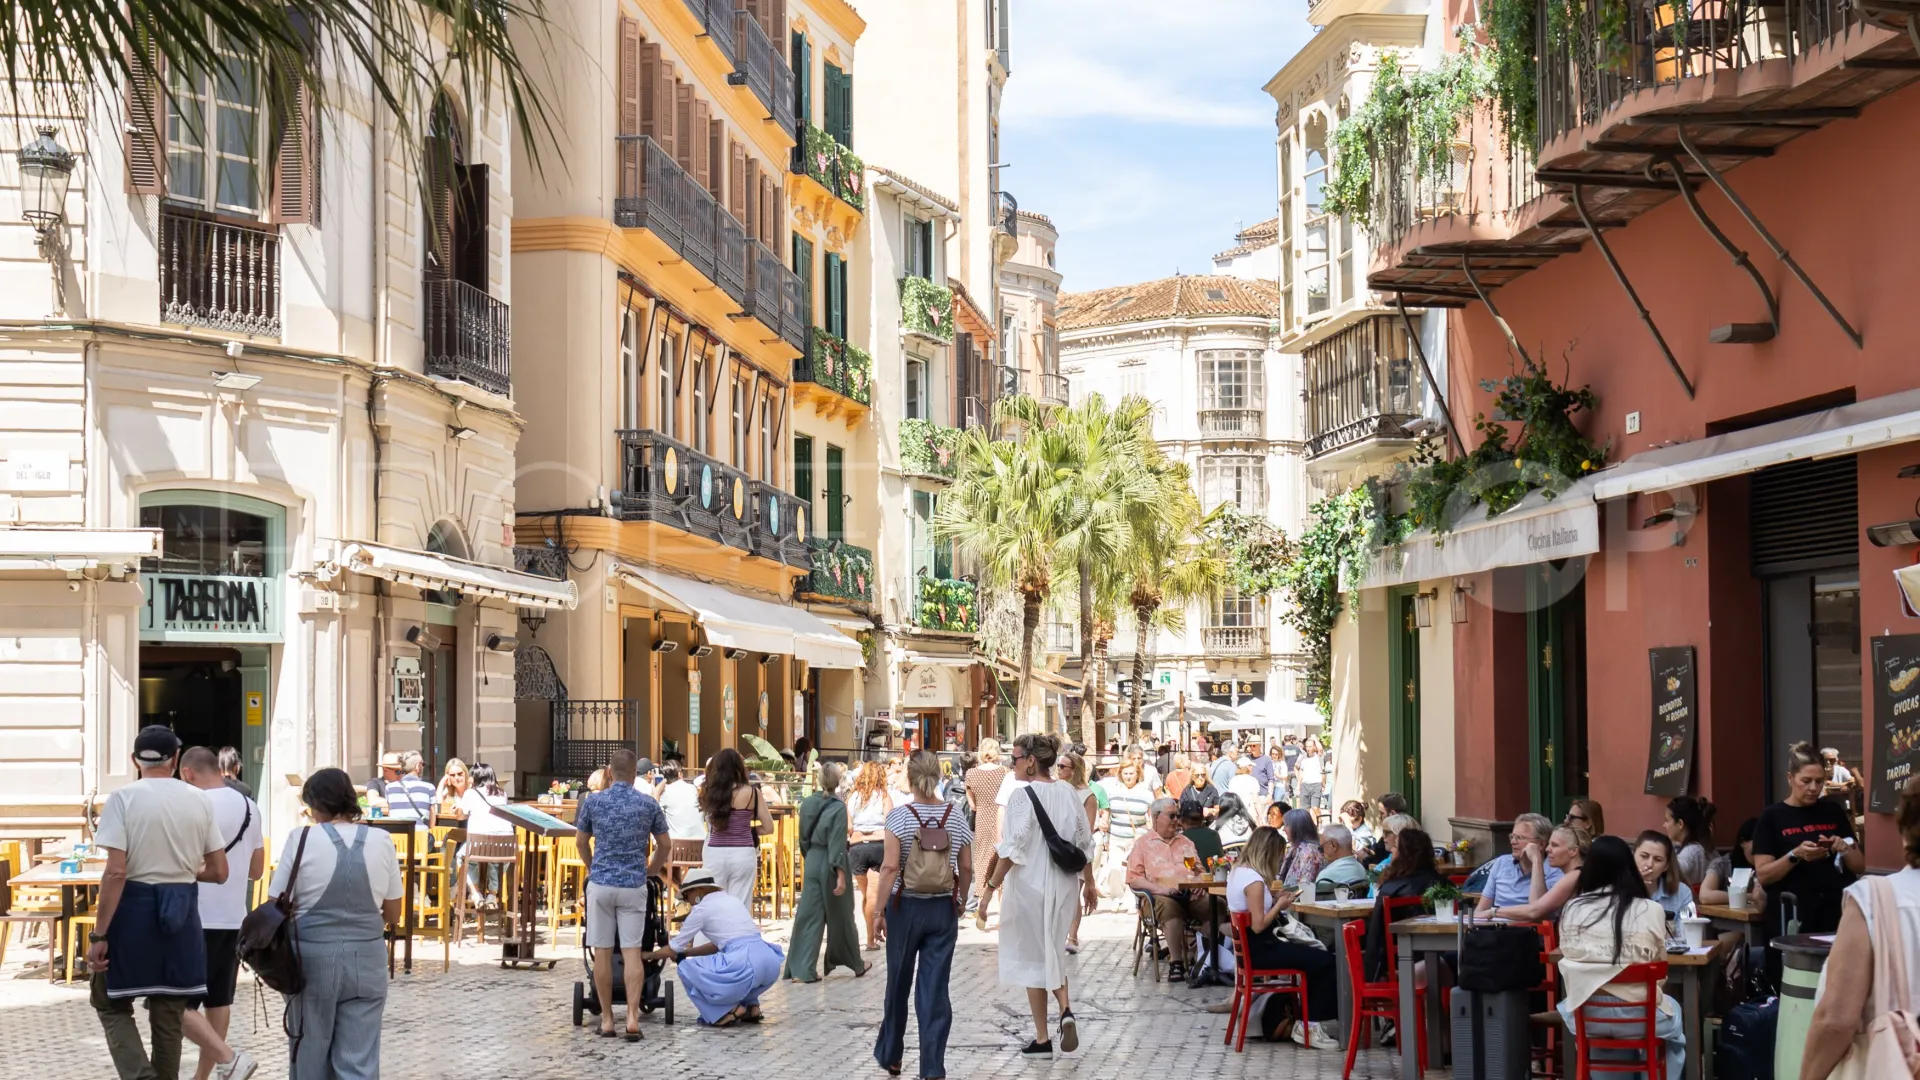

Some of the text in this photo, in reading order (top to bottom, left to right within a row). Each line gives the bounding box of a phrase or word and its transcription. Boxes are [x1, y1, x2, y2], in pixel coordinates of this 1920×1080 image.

[1528, 527, 1578, 550] Cucina Italiana
[158, 578, 260, 623] TABERNA
[320, 596, 329, 606] 30
[165, 622, 210, 630] PLATOS
[1893, 694, 1920, 716] GYOZAS
[1669, 759, 1684, 773] PULPO
[1886, 762, 1911, 781] TARTAR
[1894, 780, 1902, 790] DE
